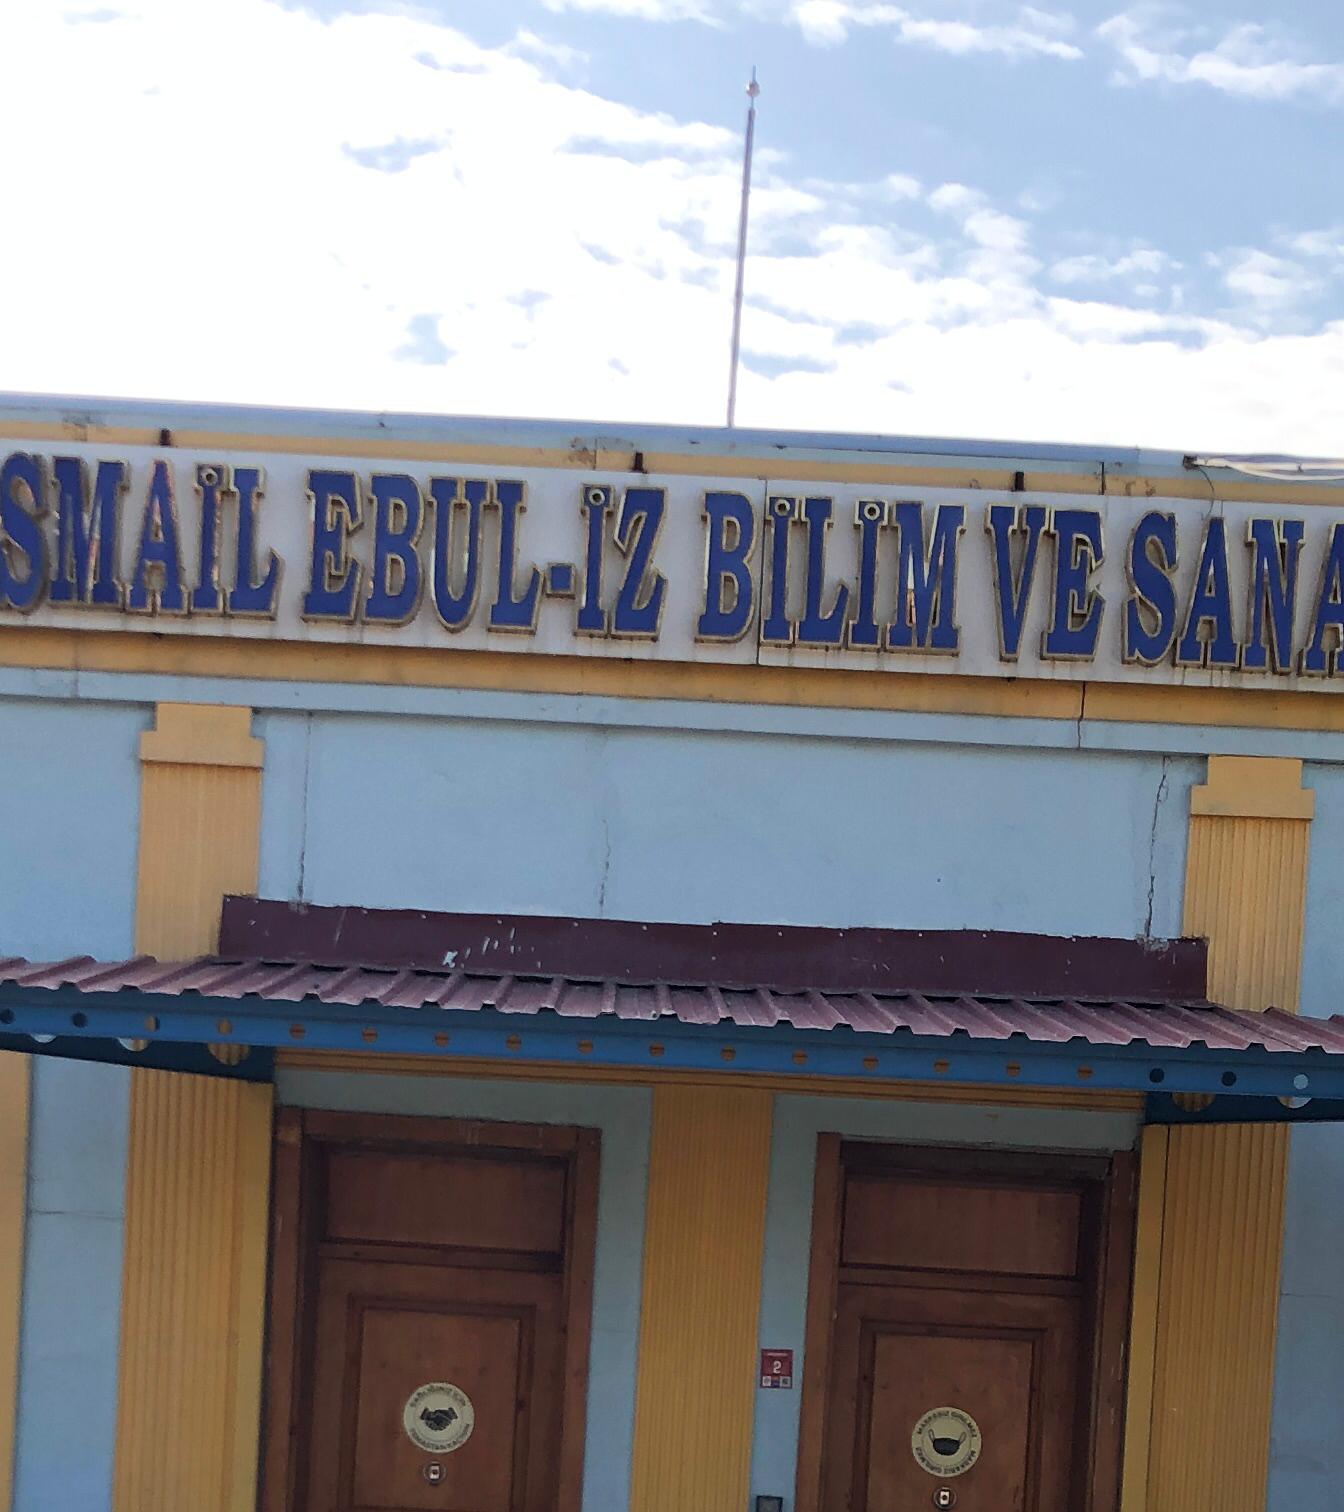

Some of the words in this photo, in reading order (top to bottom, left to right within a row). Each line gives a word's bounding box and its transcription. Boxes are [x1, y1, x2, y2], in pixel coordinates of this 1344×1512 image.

[302, 468, 669, 642] EBUL-İZ
[695, 490, 967, 656] BİLİM
[985, 503, 1106, 662] VE
